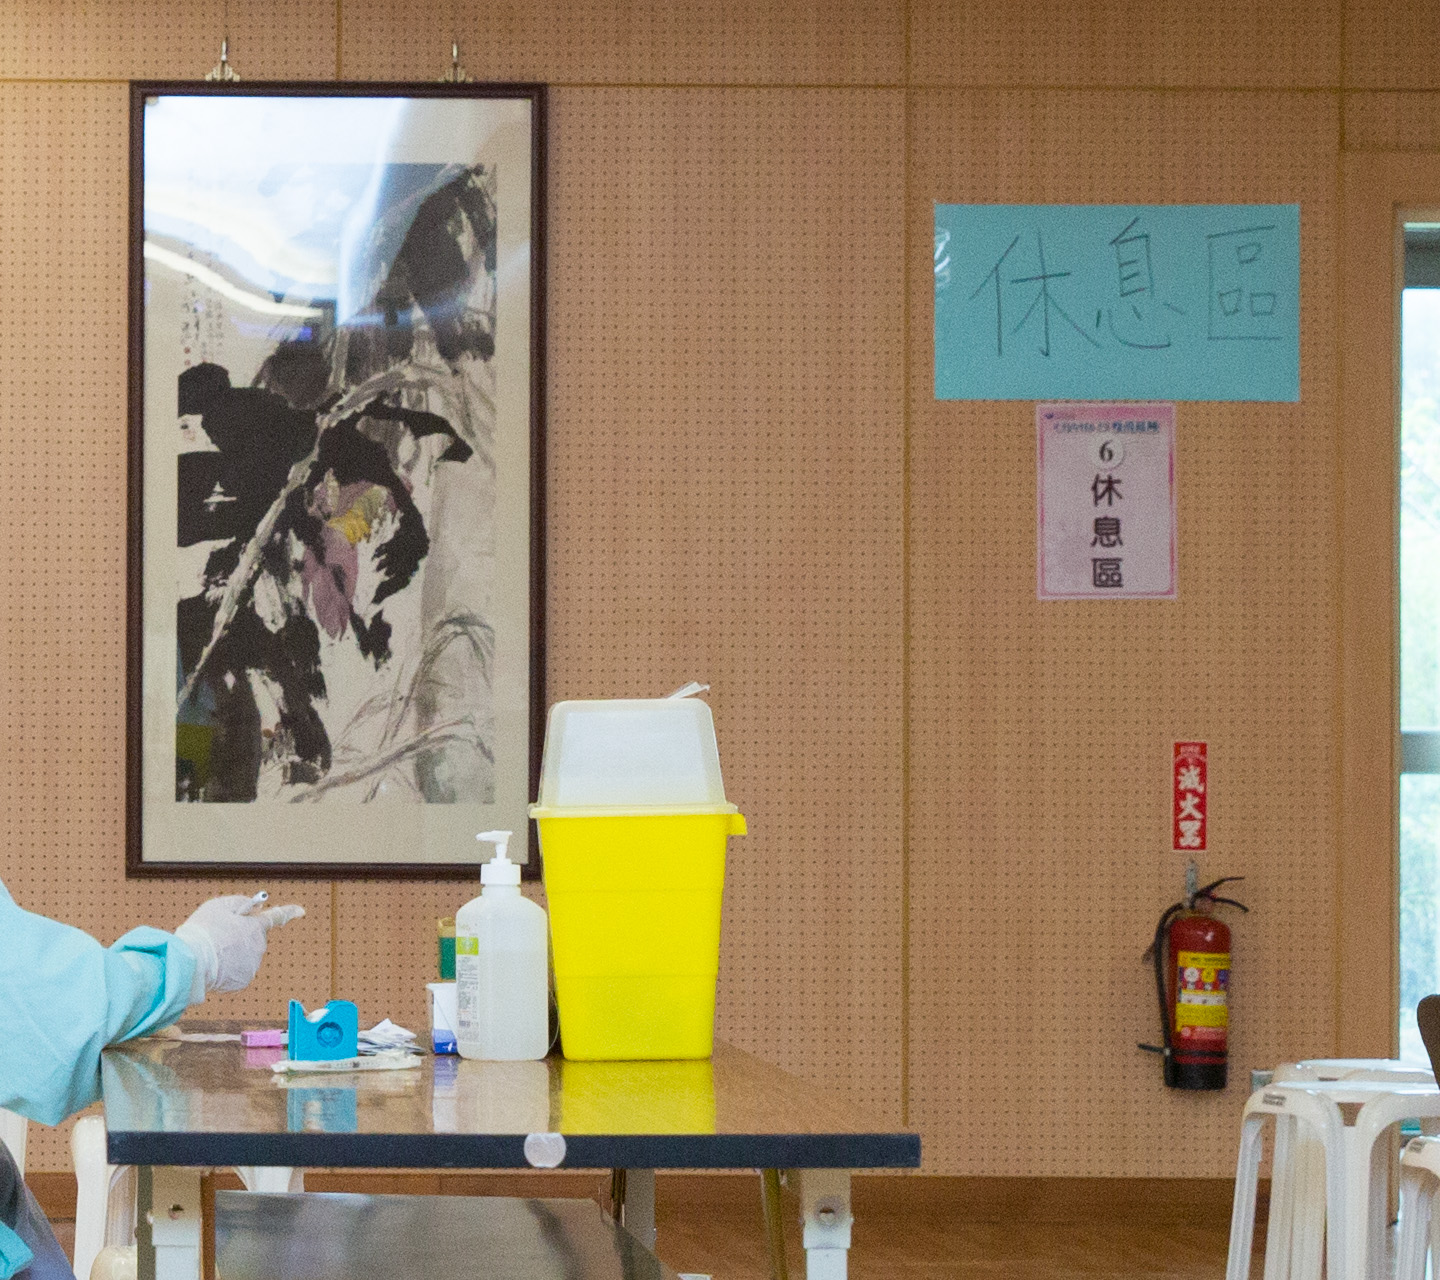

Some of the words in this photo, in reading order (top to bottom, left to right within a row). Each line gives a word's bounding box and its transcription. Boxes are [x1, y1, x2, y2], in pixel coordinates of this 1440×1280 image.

[969, 215, 1283, 357] 休息區
[1098, 438, 1115, 463] 6
[1090, 473, 1125, 589] 休息區
